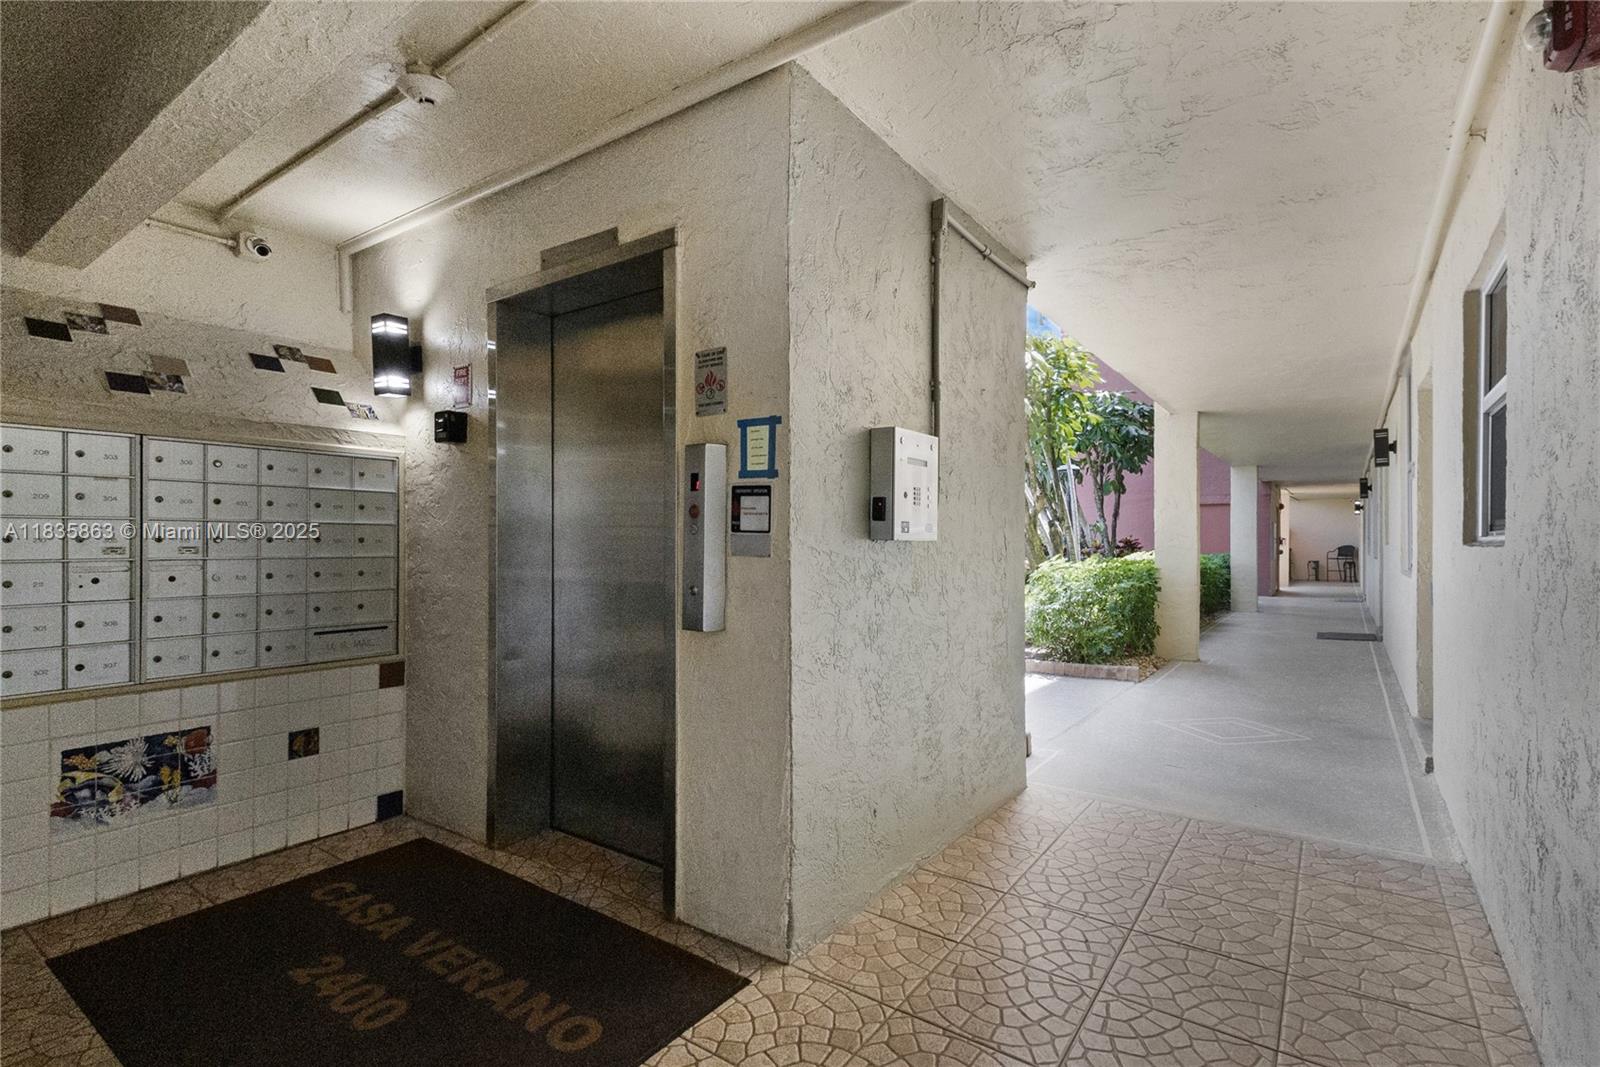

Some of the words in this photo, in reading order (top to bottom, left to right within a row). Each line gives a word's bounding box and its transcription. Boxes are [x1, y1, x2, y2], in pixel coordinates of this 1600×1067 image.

[289, 953, 410, 1032] 2400
[311, 881, 417, 942] CASA
[401, 929, 604, 1052] VERANO
